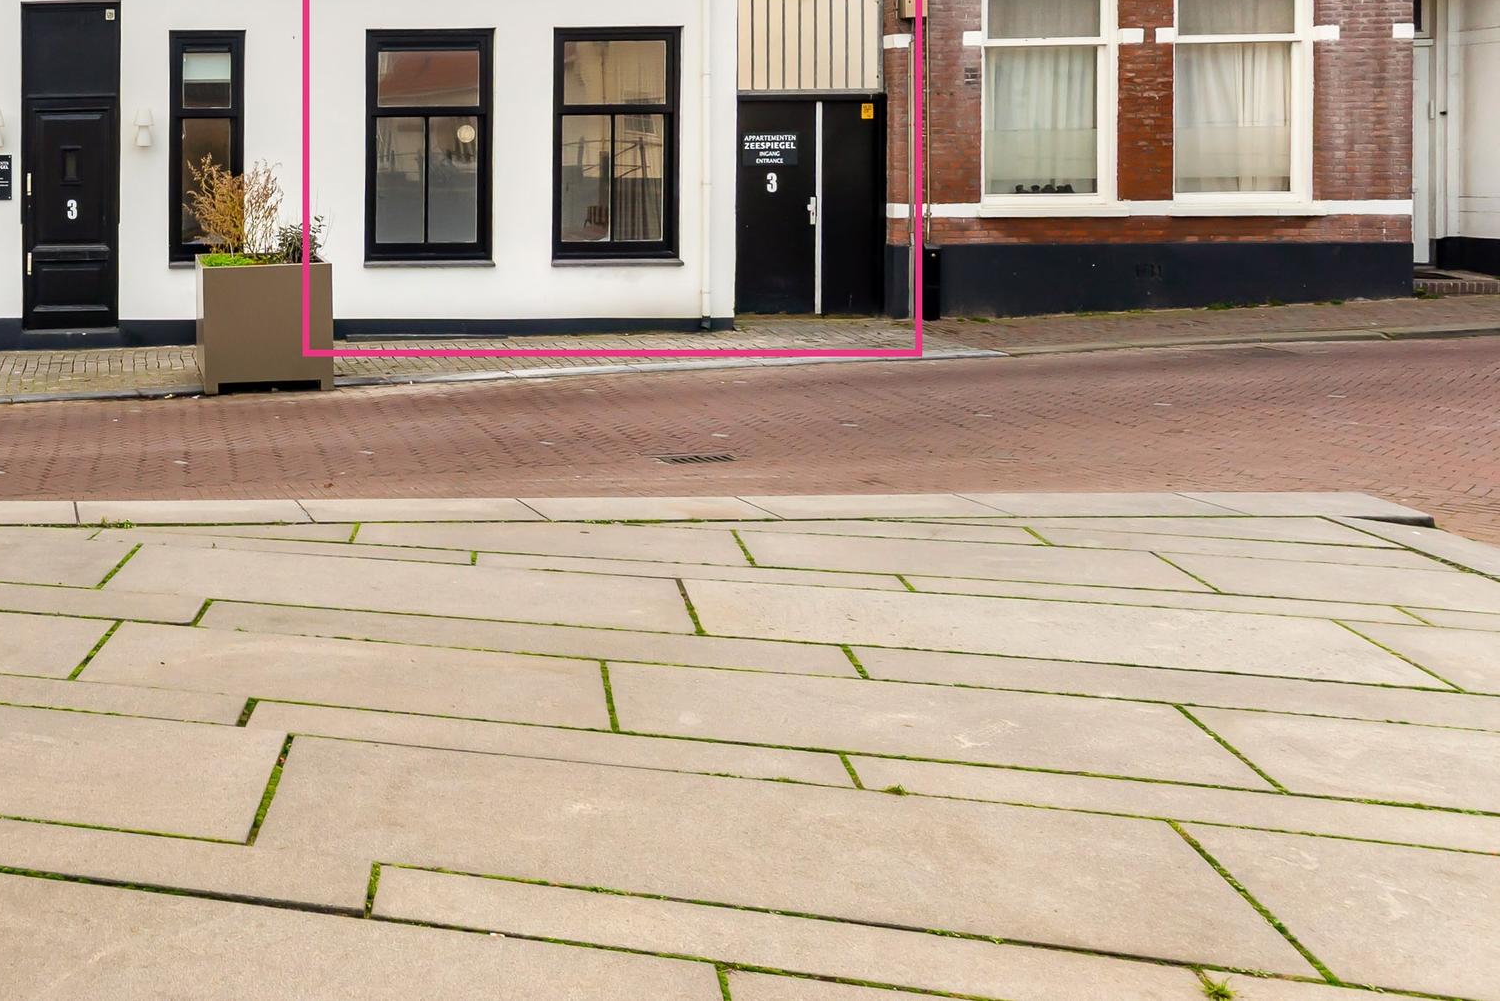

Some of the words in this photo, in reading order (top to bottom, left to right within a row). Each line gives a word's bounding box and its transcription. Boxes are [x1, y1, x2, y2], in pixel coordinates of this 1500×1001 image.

[744, 142, 797, 150] ZEESPIEGEL
[766, 172, 778, 193] 3
[66, 199, 78, 220] 3
